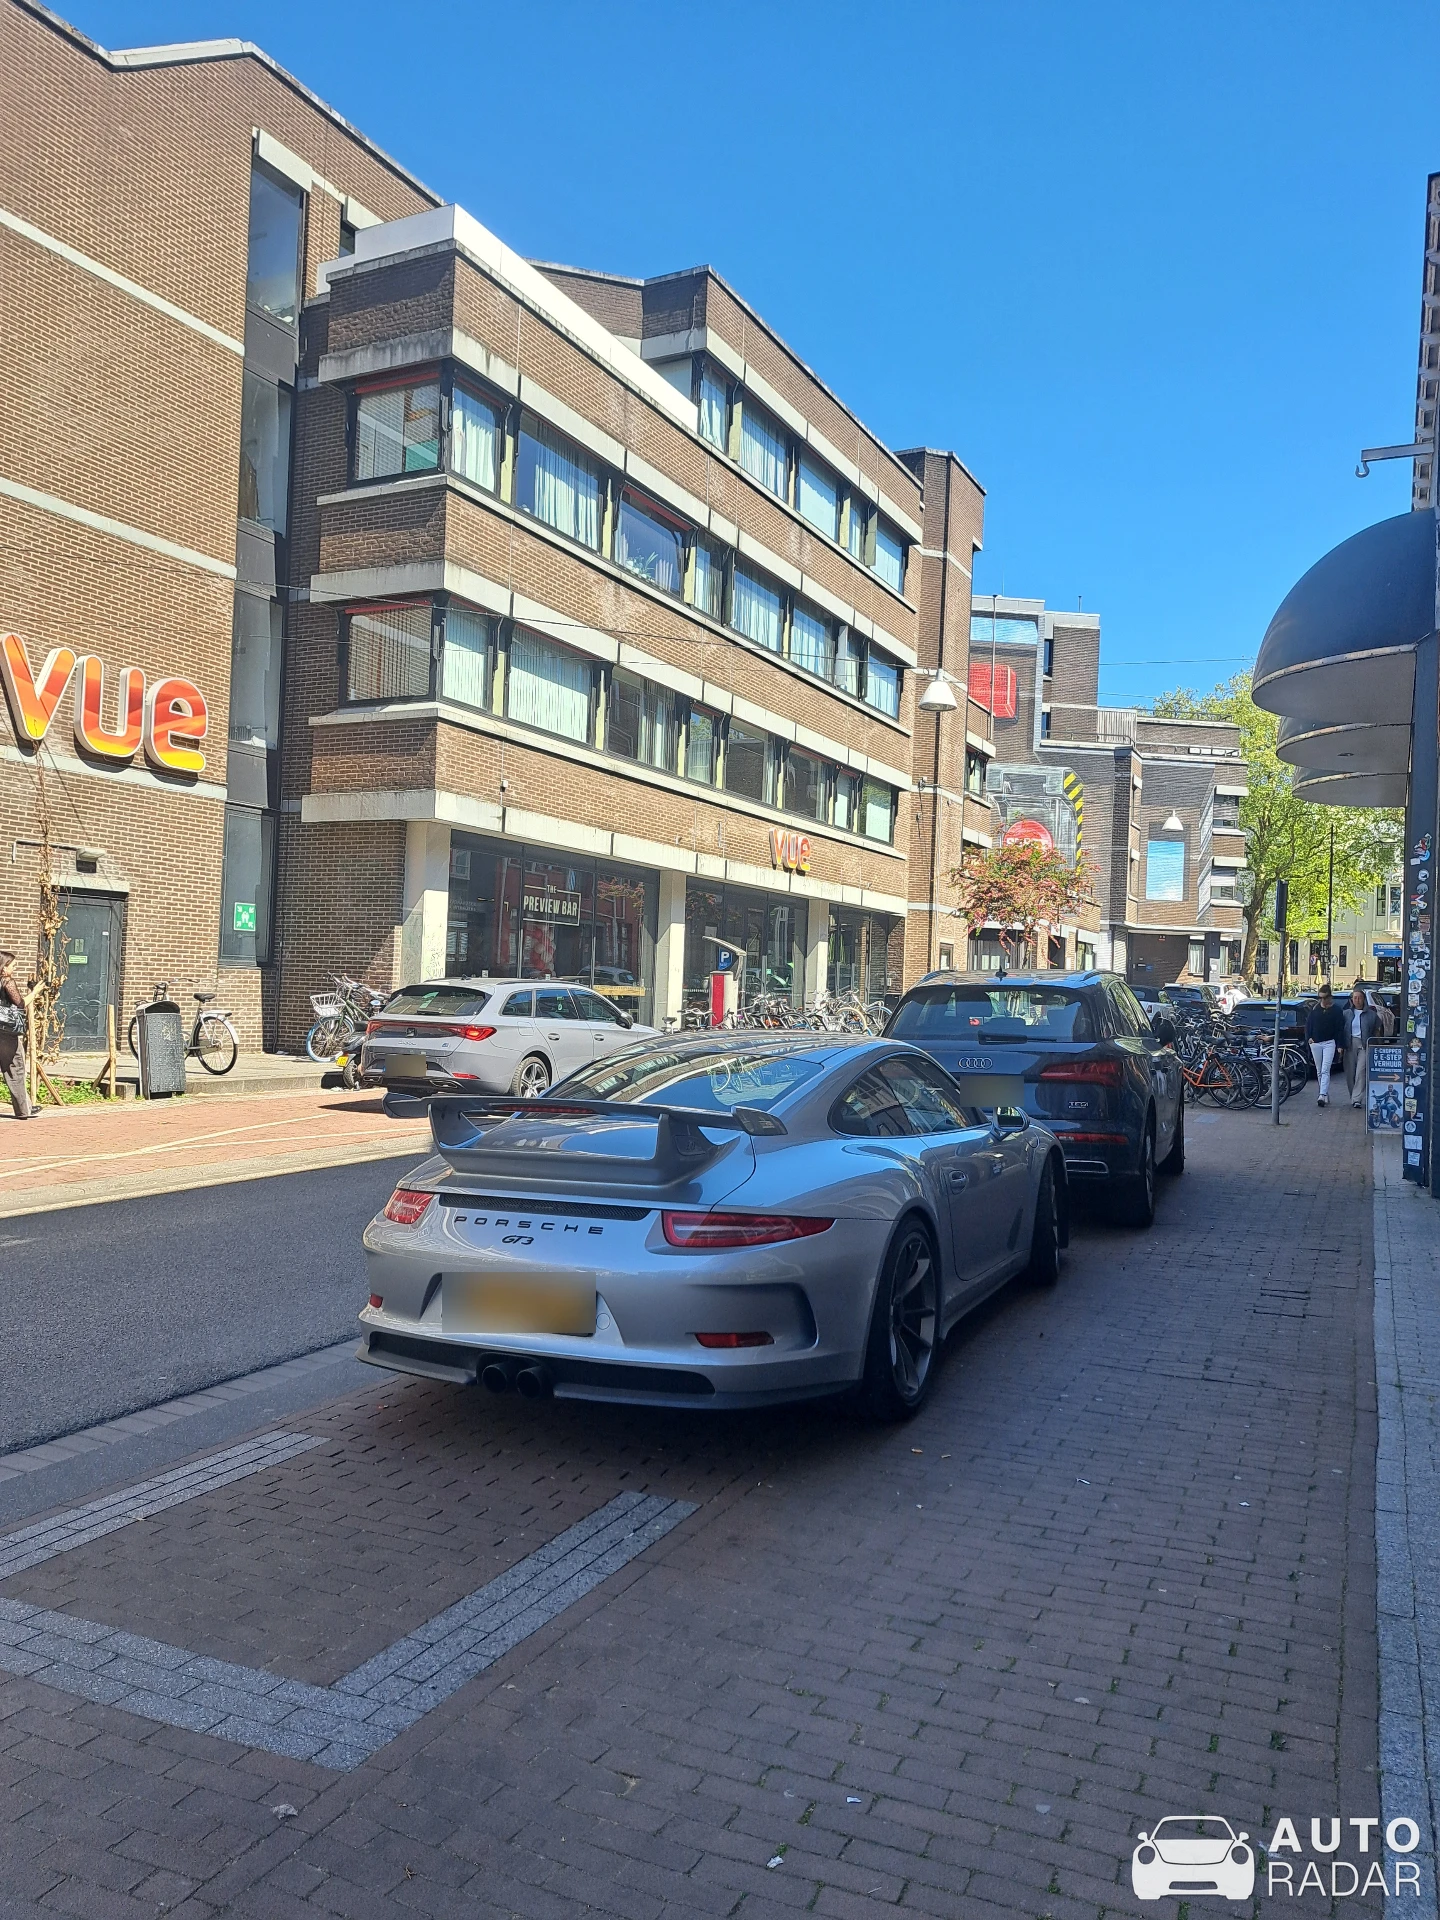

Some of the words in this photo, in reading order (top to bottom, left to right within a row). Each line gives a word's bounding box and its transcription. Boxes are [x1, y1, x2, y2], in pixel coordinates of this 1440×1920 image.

[547, 885, 557, 894] THE
[523, 895, 560, 914] PREVIEW
[561, 900, 578, 917] BAR
[720, 951, 730, 962] P
[1374, 1060, 1402, 1068] VERHUUR
[454, 1215, 604, 1235] PORSCHE
[501, 1234, 535, 1246] GT3
